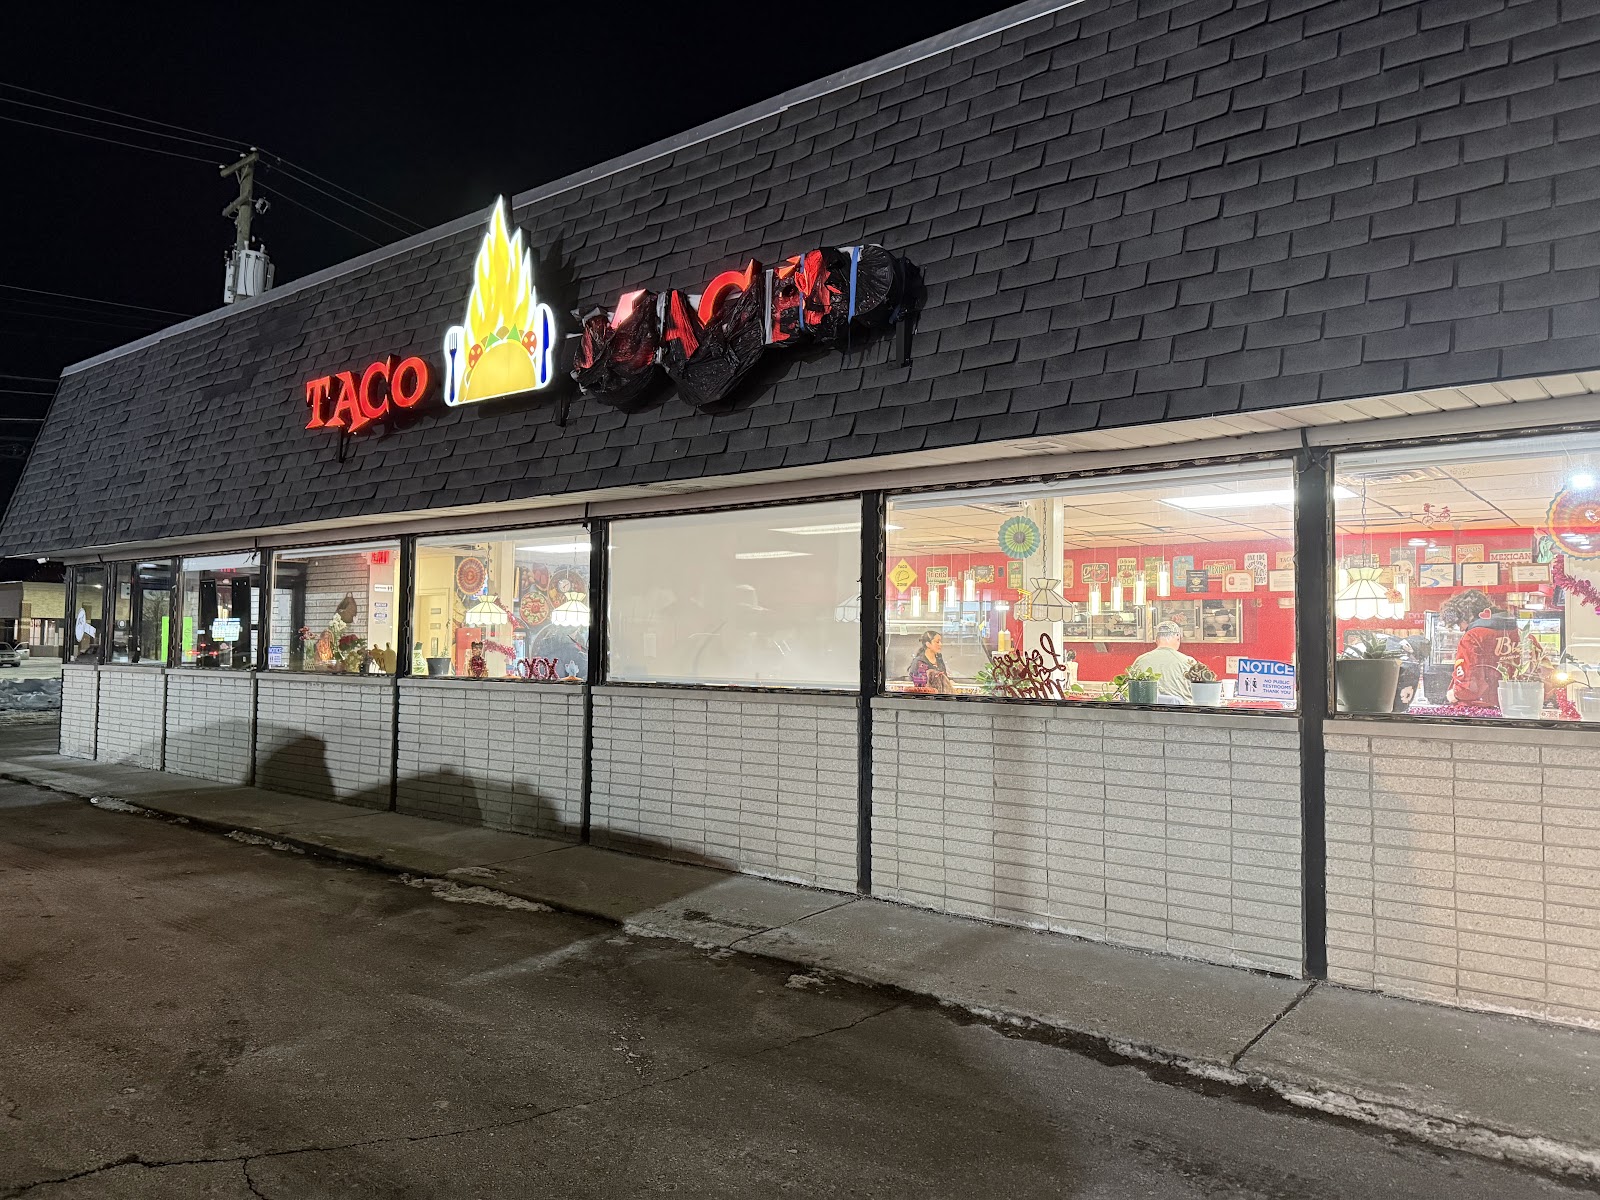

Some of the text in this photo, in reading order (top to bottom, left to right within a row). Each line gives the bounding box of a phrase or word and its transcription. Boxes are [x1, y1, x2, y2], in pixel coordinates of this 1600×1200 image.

[305, 356, 428, 433] TACO
[1490, 552, 1531, 561] MEXICAN
[1239, 660, 1295, 676] NOTICE
